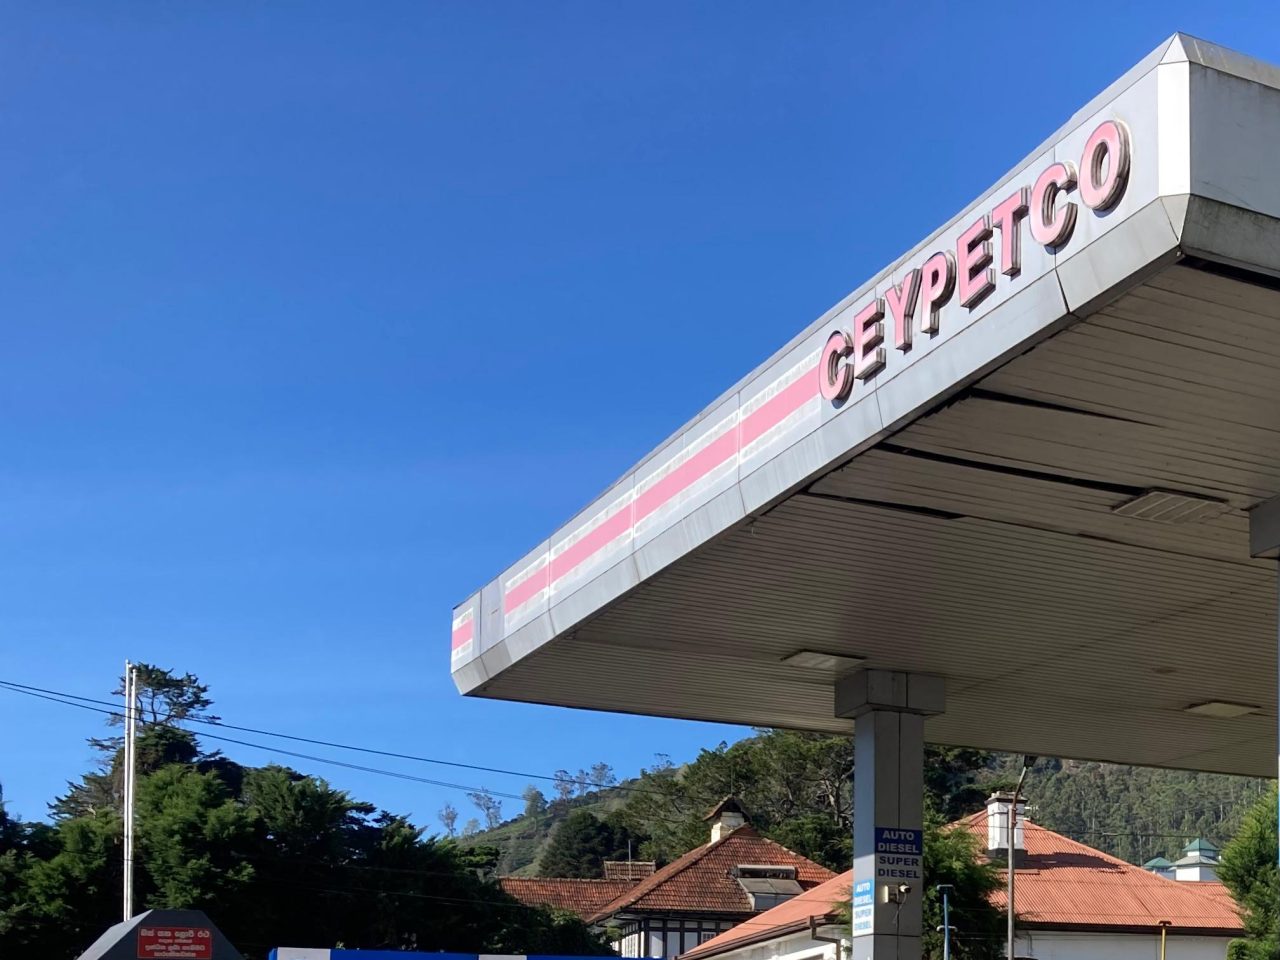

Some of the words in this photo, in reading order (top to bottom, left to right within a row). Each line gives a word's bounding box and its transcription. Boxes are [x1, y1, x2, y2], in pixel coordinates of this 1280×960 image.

[819, 119, 1132, 403] CEYPETCO
[882, 830, 914, 841] AUTO
[877, 842, 919, 853] DIESEL
[879, 856, 919, 867] SUPER
[877, 869, 920, 879] DIESEL
[856, 882, 870, 893] AUTO
[854, 894, 872, 906] DIESEL
[854, 908, 872, 918] SUPER
